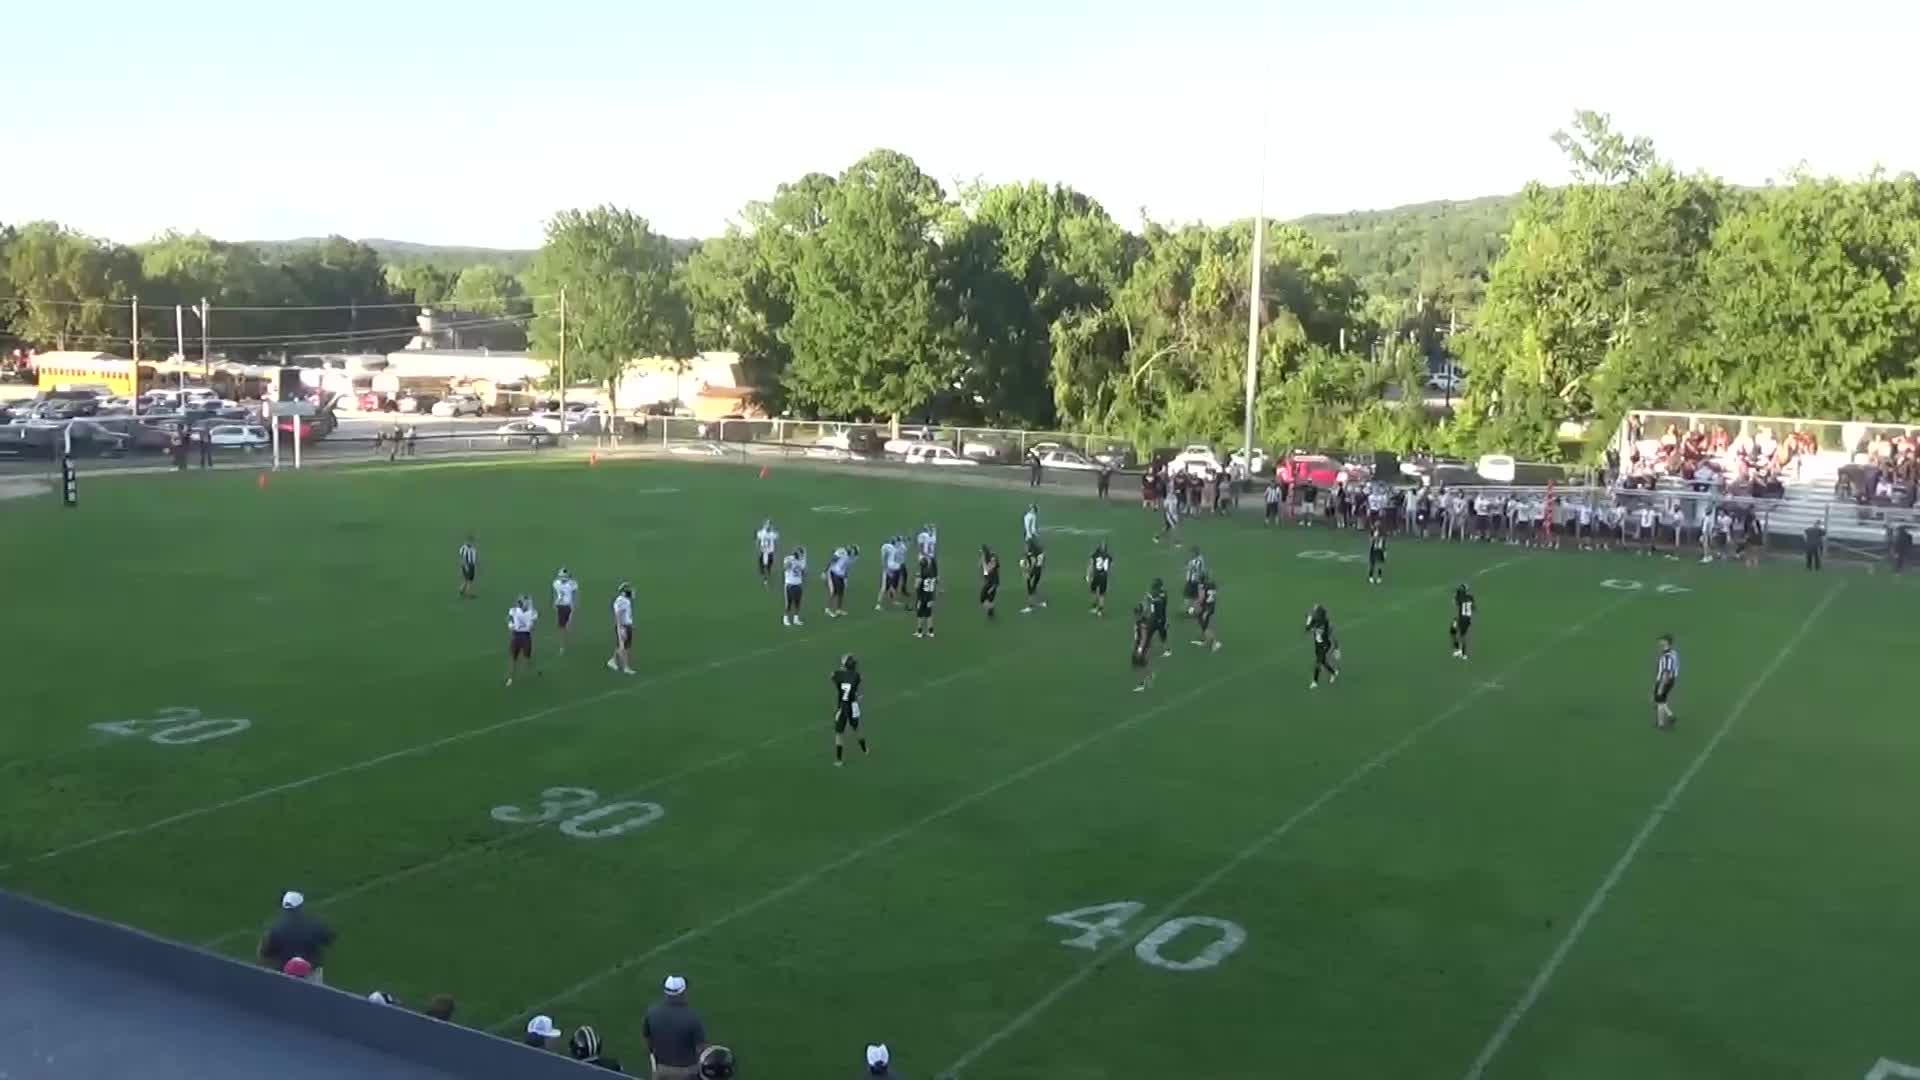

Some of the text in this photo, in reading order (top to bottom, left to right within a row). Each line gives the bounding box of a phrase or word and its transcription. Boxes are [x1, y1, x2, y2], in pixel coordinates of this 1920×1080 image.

[840, 682, 852, 701] 7
[490, 786, 665, 838] 30
[1045, 901, 1247, 971] 40
